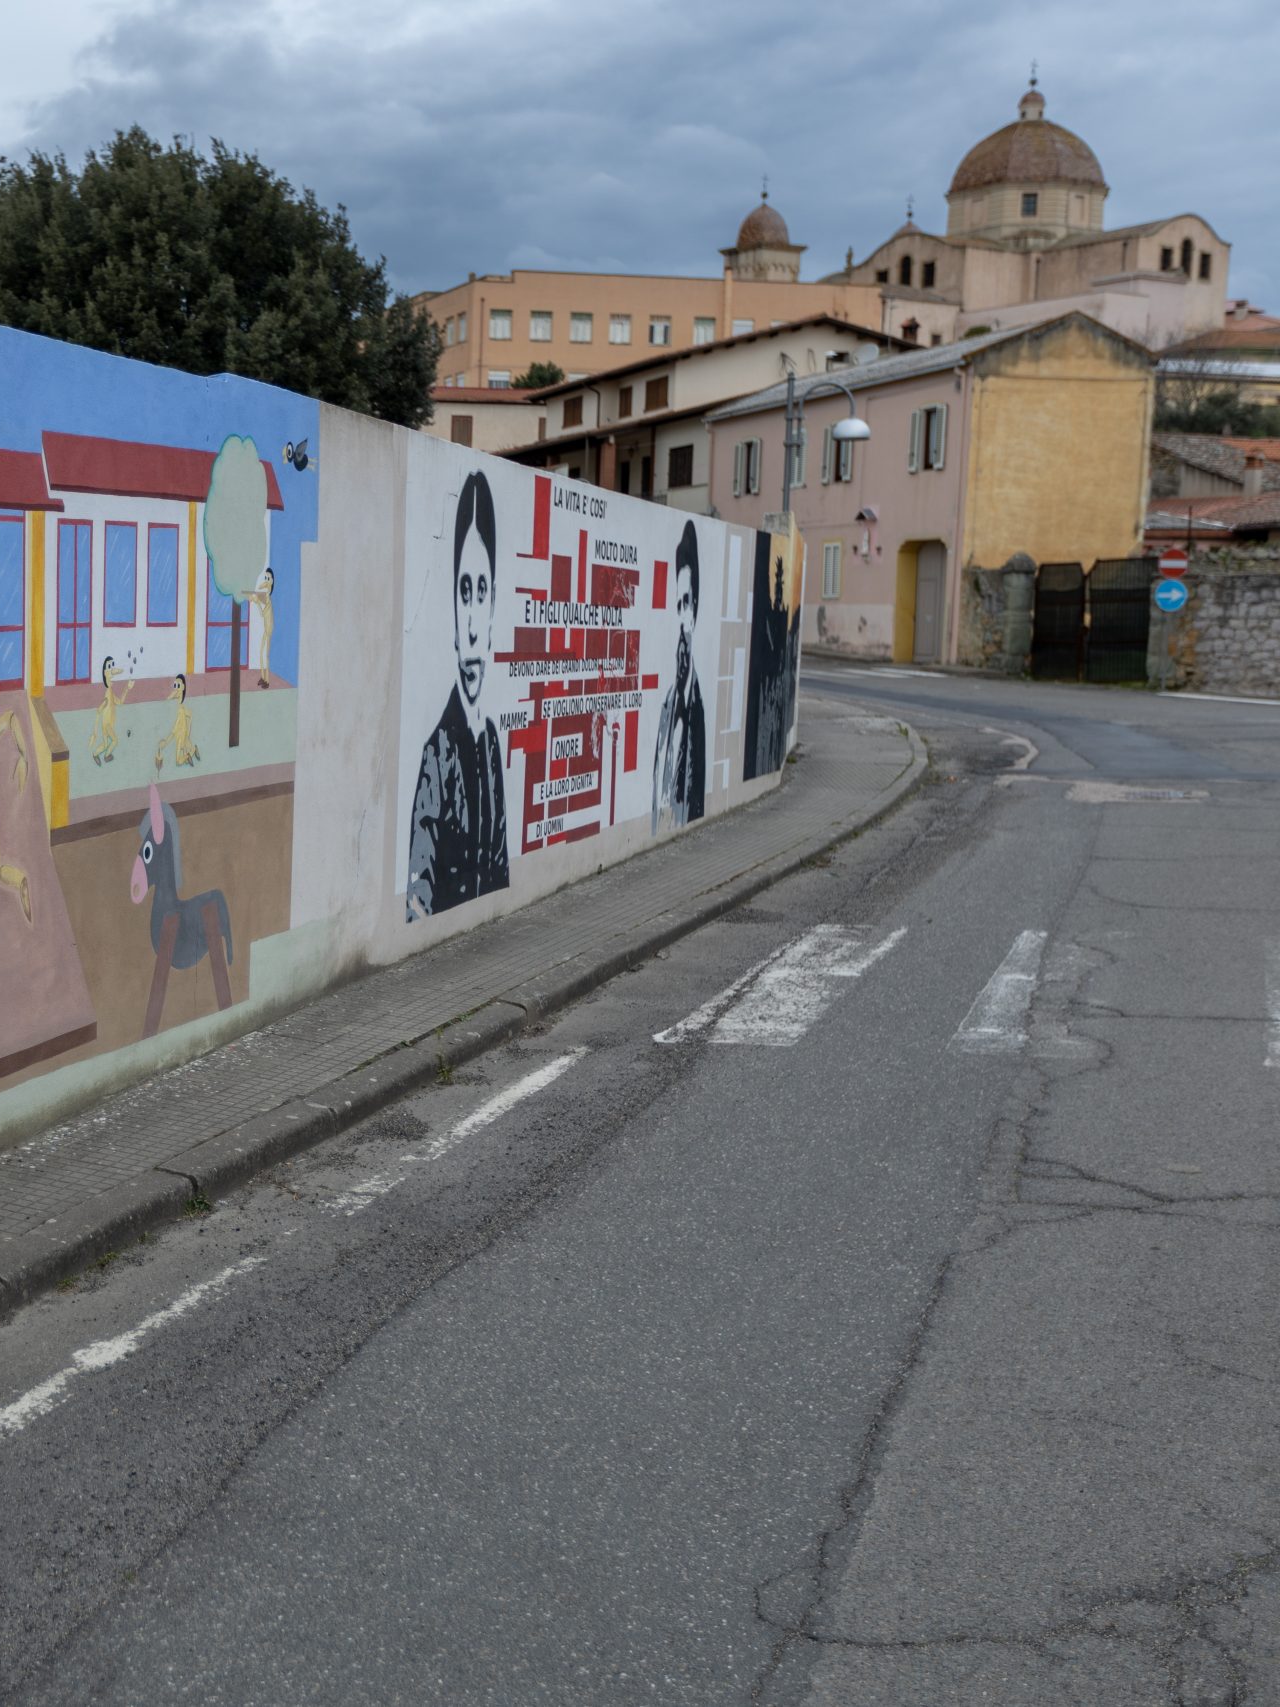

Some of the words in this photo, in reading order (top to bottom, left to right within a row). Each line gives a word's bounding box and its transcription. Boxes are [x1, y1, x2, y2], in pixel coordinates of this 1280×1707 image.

[554, 486, 563, 509] LA
[565, 490, 580, 514] VITA
[595, 539, 618, 562] MOLTO
[620, 544, 637, 565] DURA
[525, 600, 531, 623] E
[539, 601, 561, 625] FIGLI
[562, 602, 599, 628] QUALCHE
[601, 605, 623, 626] VOLTA
[509, 660, 534, 677] DEVONO
[536, 660, 551, 676] DARE
[552, 659, 560, 675] DEI
[543, 700, 552, 718] SE
[553, 697, 584, 717] VOGLIONO
[585, 693, 622, 713] CONSERVARE
[628, 692, 643, 708] LORO
[500, 711, 528, 731] MAMME
[555, 738, 579, 760] ONORE
[545, 781, 554, 798] LA
[554, 777, 570, 796] LORO
[544, 818, 564, 836] UOMINI
